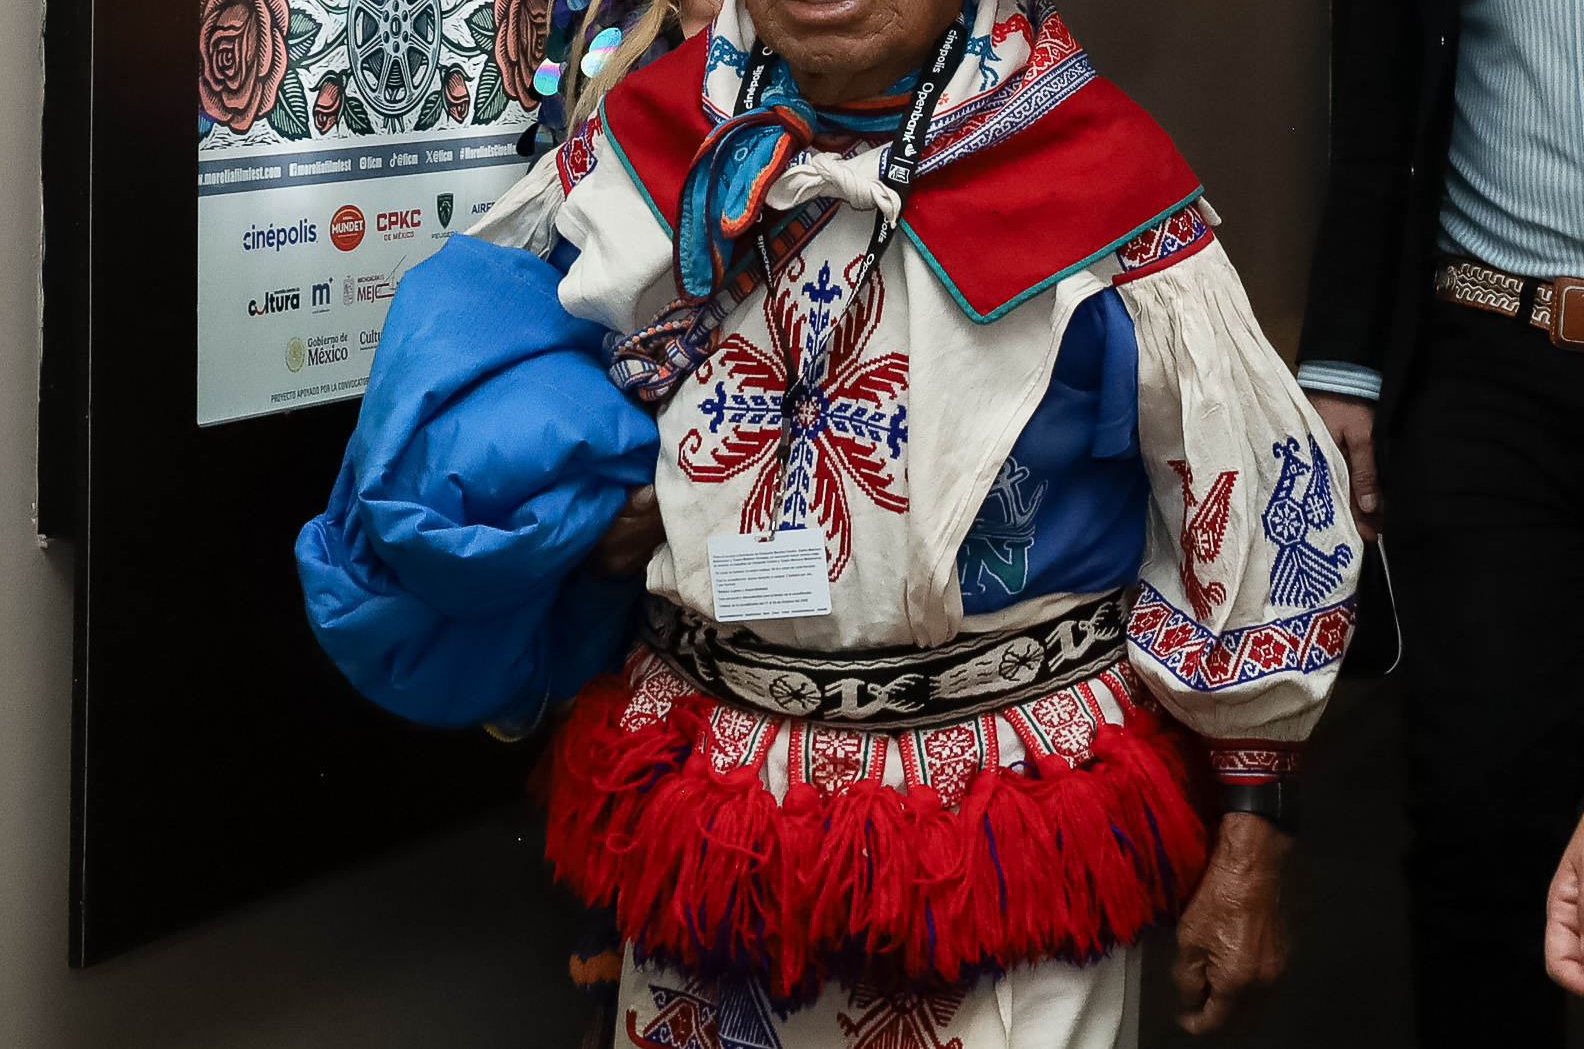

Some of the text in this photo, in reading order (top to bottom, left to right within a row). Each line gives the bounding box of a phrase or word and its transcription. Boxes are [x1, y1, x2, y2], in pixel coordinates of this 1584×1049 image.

[932, 29, 958, 74] cinépolis
[743, 64, 765, 110] cinépolis
[901, 81, 935, 143] Openbank
[471, 202, 496, 215] AIRF
[331, 219, 364, 235] MUNDET
[376, 209, 422, 232] CPKC
[242, 218, 317, 252] cinépolis
[392, 231, 415, 241] MÉXICO
[247, 292, 301, 316] cultura
[307, 332, 348, 348] Gobierno de
[307, 344, 349, 367] México
[320, 384, 330, 394] POR
[331, 383, 338, 392] LA
